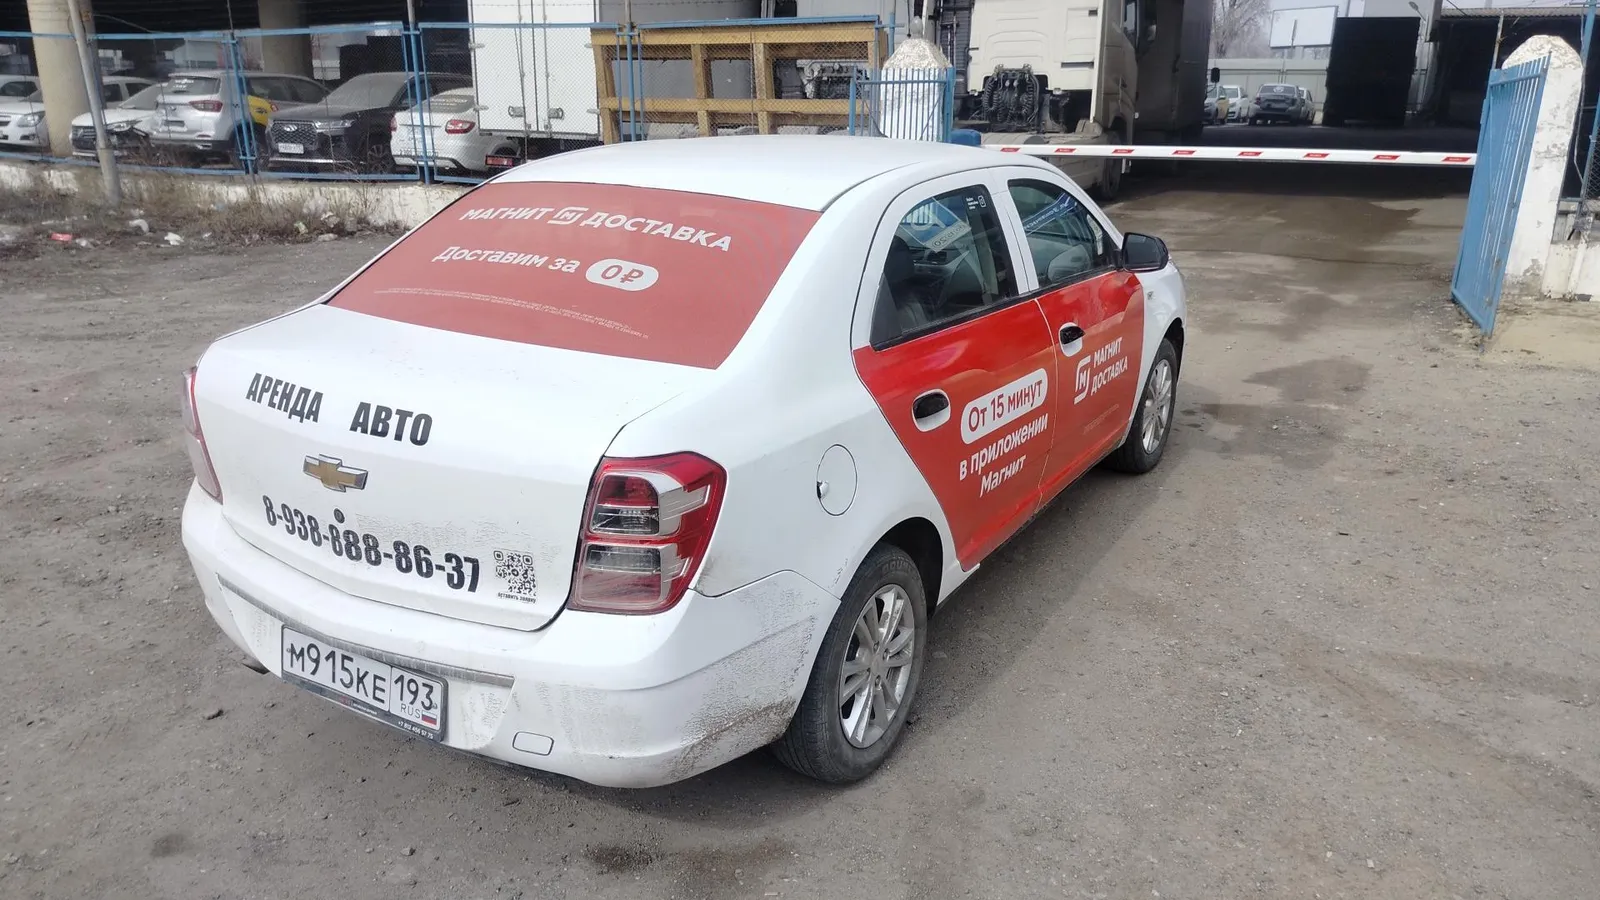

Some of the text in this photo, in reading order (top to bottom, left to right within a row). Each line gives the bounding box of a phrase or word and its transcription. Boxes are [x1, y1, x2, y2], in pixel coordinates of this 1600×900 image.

[459, 205, 553, 222] МАГНИТ
[583, 211, 733, 252] ДОСТАВКА
[431, 245, 548, 269] Доставим
[548, 257, 580, 273] за
[1091, 356, 1127, 396] ДОСТАВКА
[1093, 337, 1122, 369] МАГНИТ
[245, 373, 433, 446] АРЕНДА АВТО
[968, 379, 1043, 433] От 15 минут
[959, 459, 967, 481] в
[970, 413, 1049, 476] приложении
[980, 455, 1027, 498] Магнит
[262, 495, 481, 593] 8-938-888-86-37
[290, 643, 434, 711] М915КЕ 193
[401, 703, 421, 719] RUS
